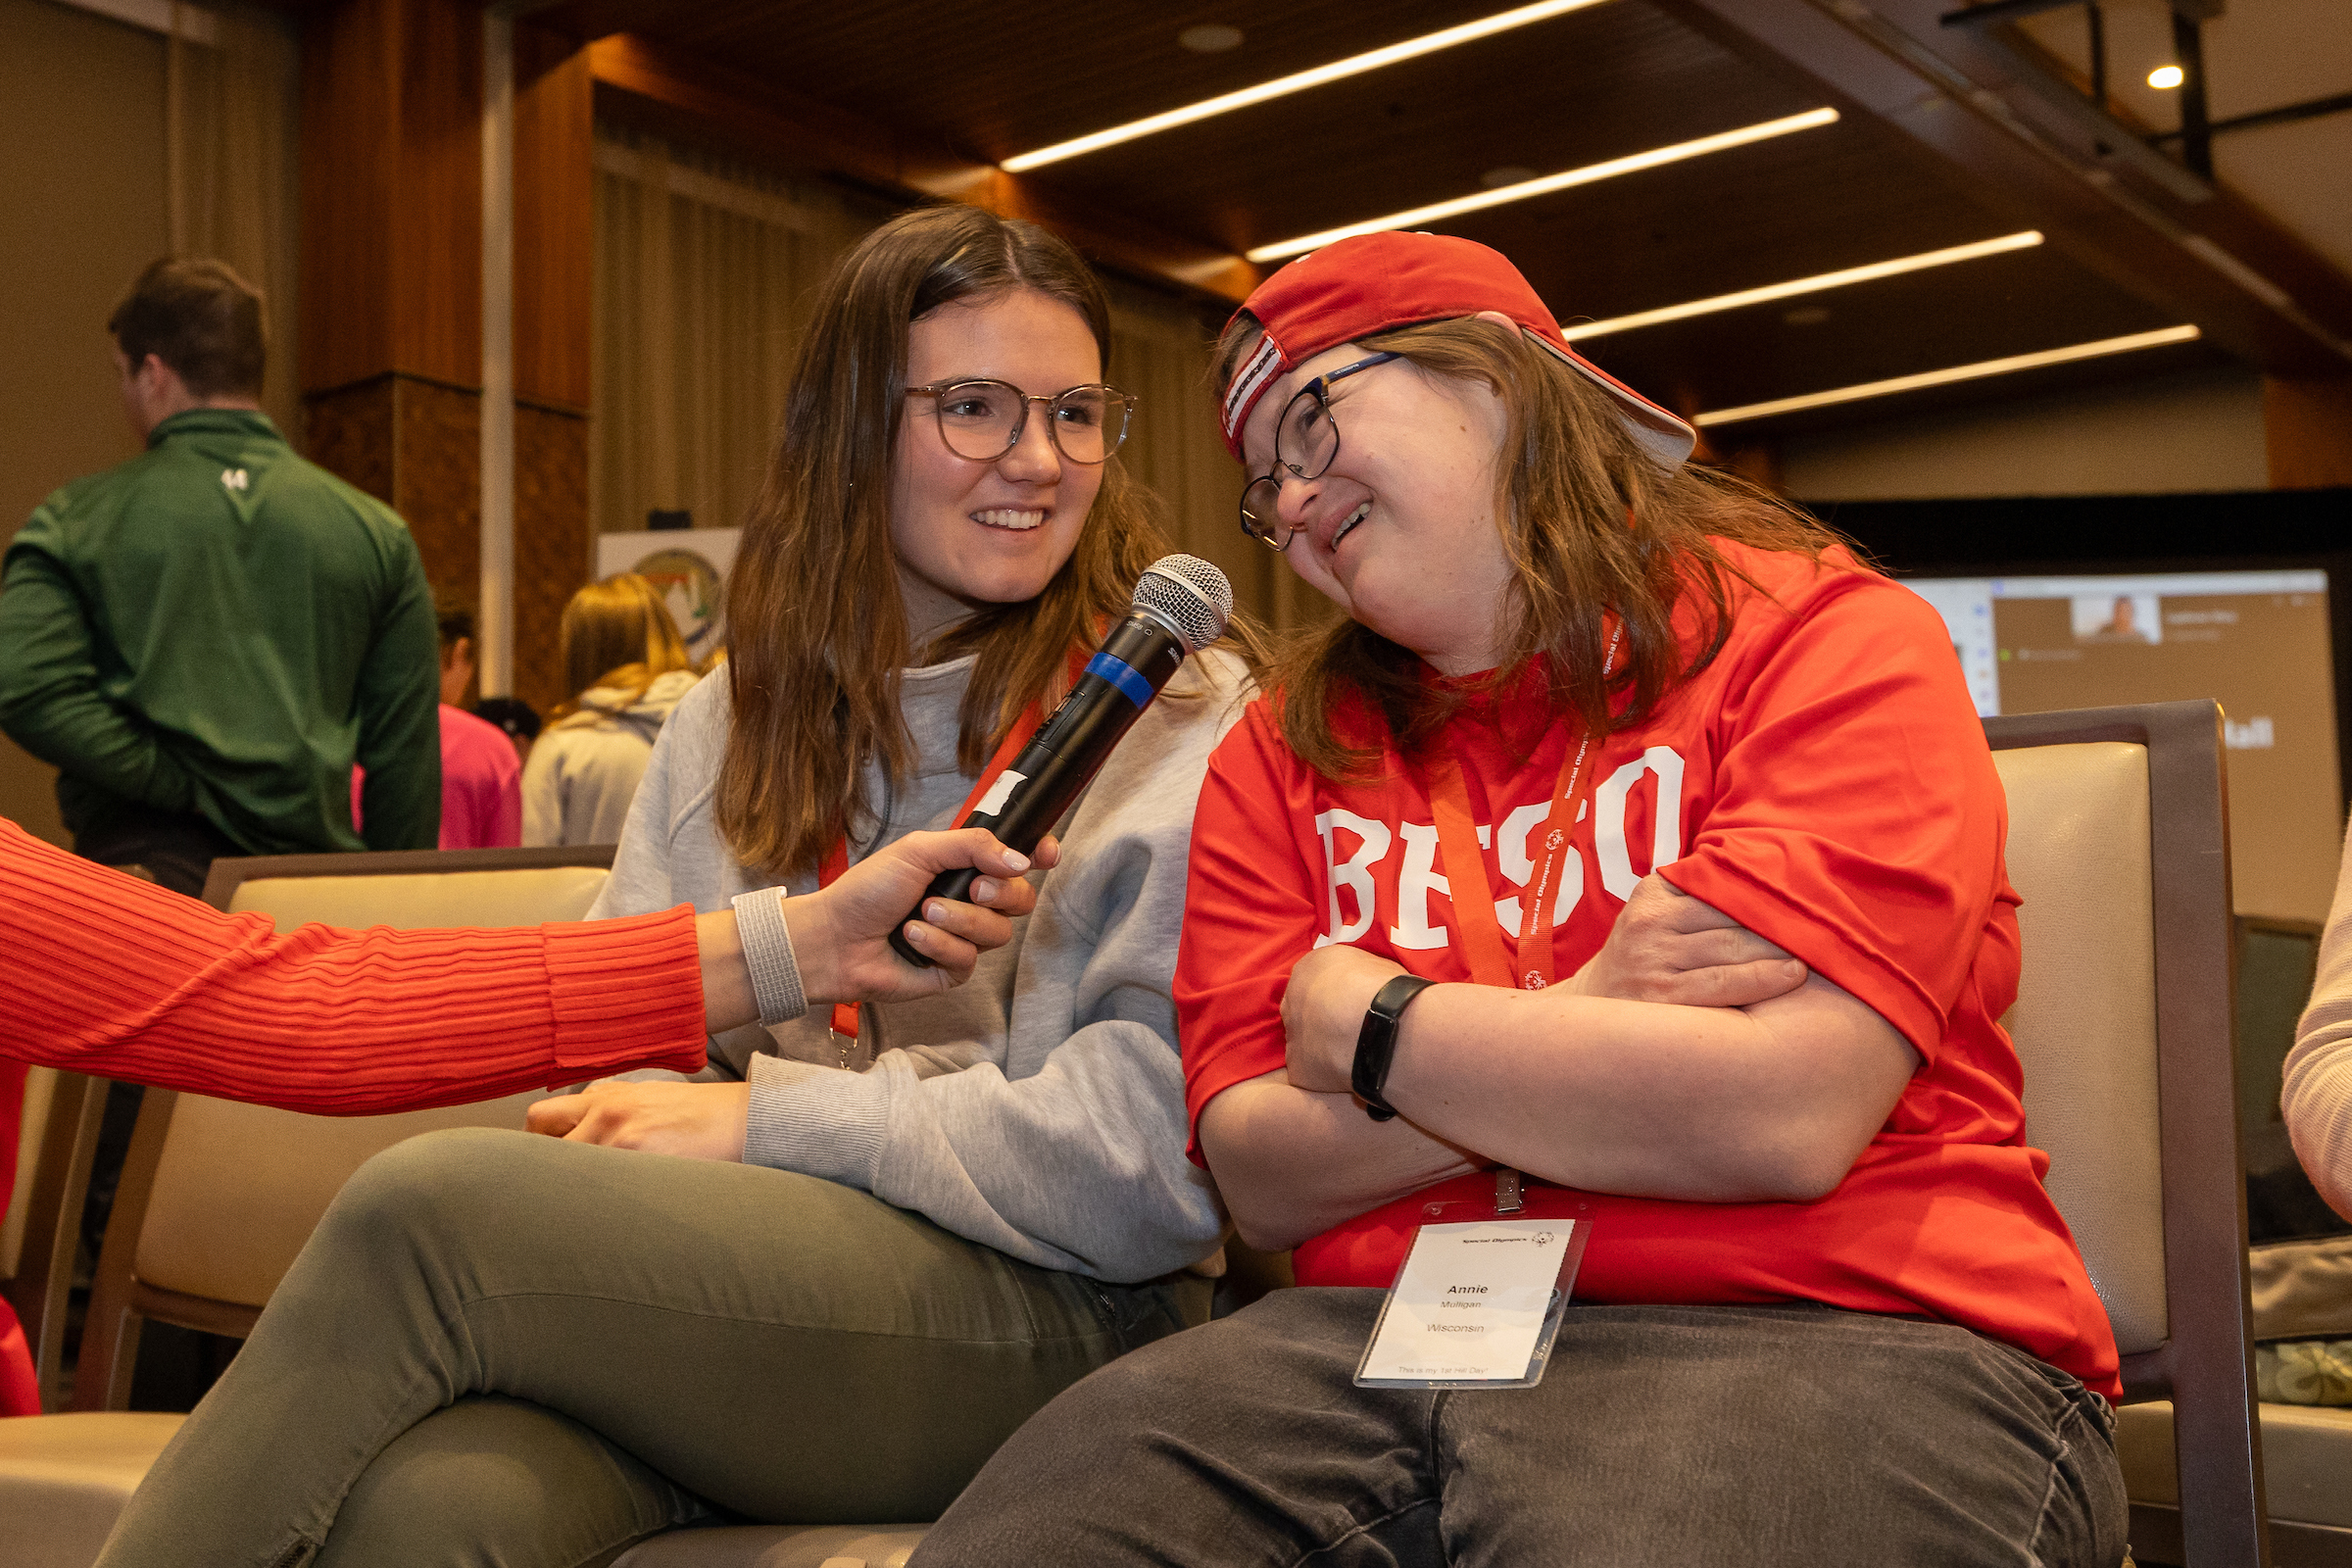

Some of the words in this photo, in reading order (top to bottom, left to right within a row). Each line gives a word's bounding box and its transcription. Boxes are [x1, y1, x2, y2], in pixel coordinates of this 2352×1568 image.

[1167, 647, 1182, 666] SHU
[1603, 643, 1617, 674] Special
[1564, 767, 1579, 800] Special
[1531, 899, 1542, 935] Special
[1538, 854, 1553, 897] Olympics
[1447, 1285, 1489, 1294] Annie
[1441, 1300, 1482, 1309] Mulligan
[1427, 1324, 1485, 1333] Wisconsin
